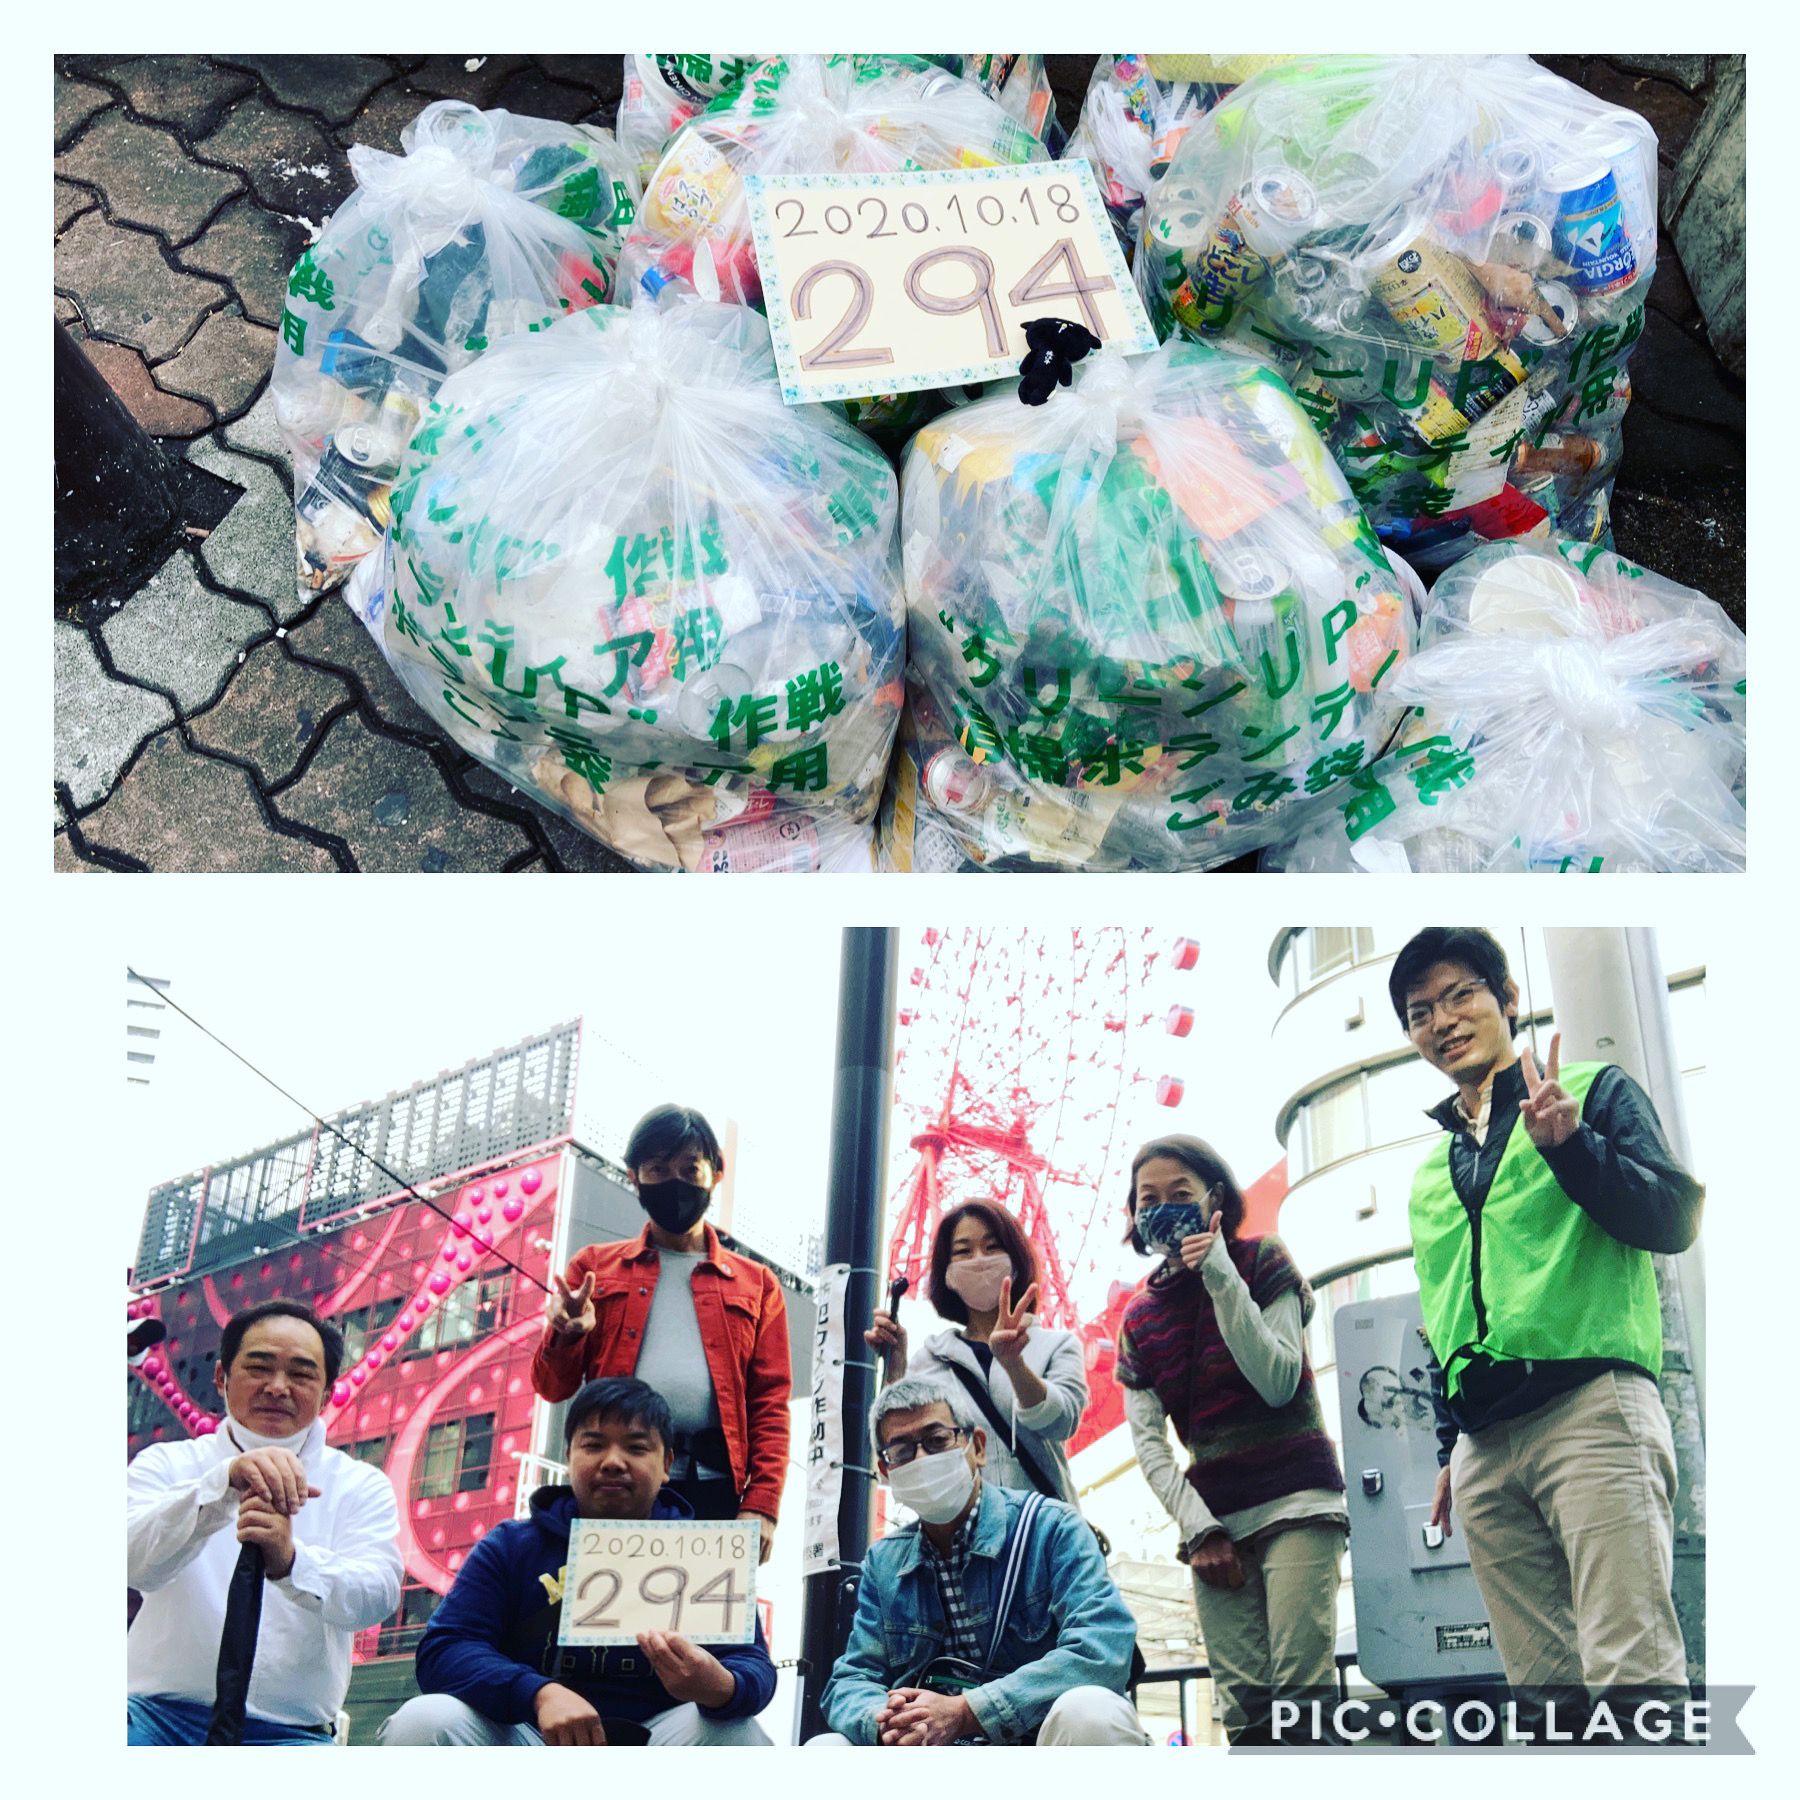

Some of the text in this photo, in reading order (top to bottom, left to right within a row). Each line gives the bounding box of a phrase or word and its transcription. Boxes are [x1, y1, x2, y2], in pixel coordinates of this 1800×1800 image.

[776, 183, 1081, 239] 2020.10.18
[1583, 249, 1636, 280] ORGIA
[790, 238, 1117, 372] 294
[708, 660, 845, 750] 作戦
[583, 1533, 745, 1559] 2020.10.18
[572, 1565, 747, 1632] 294
